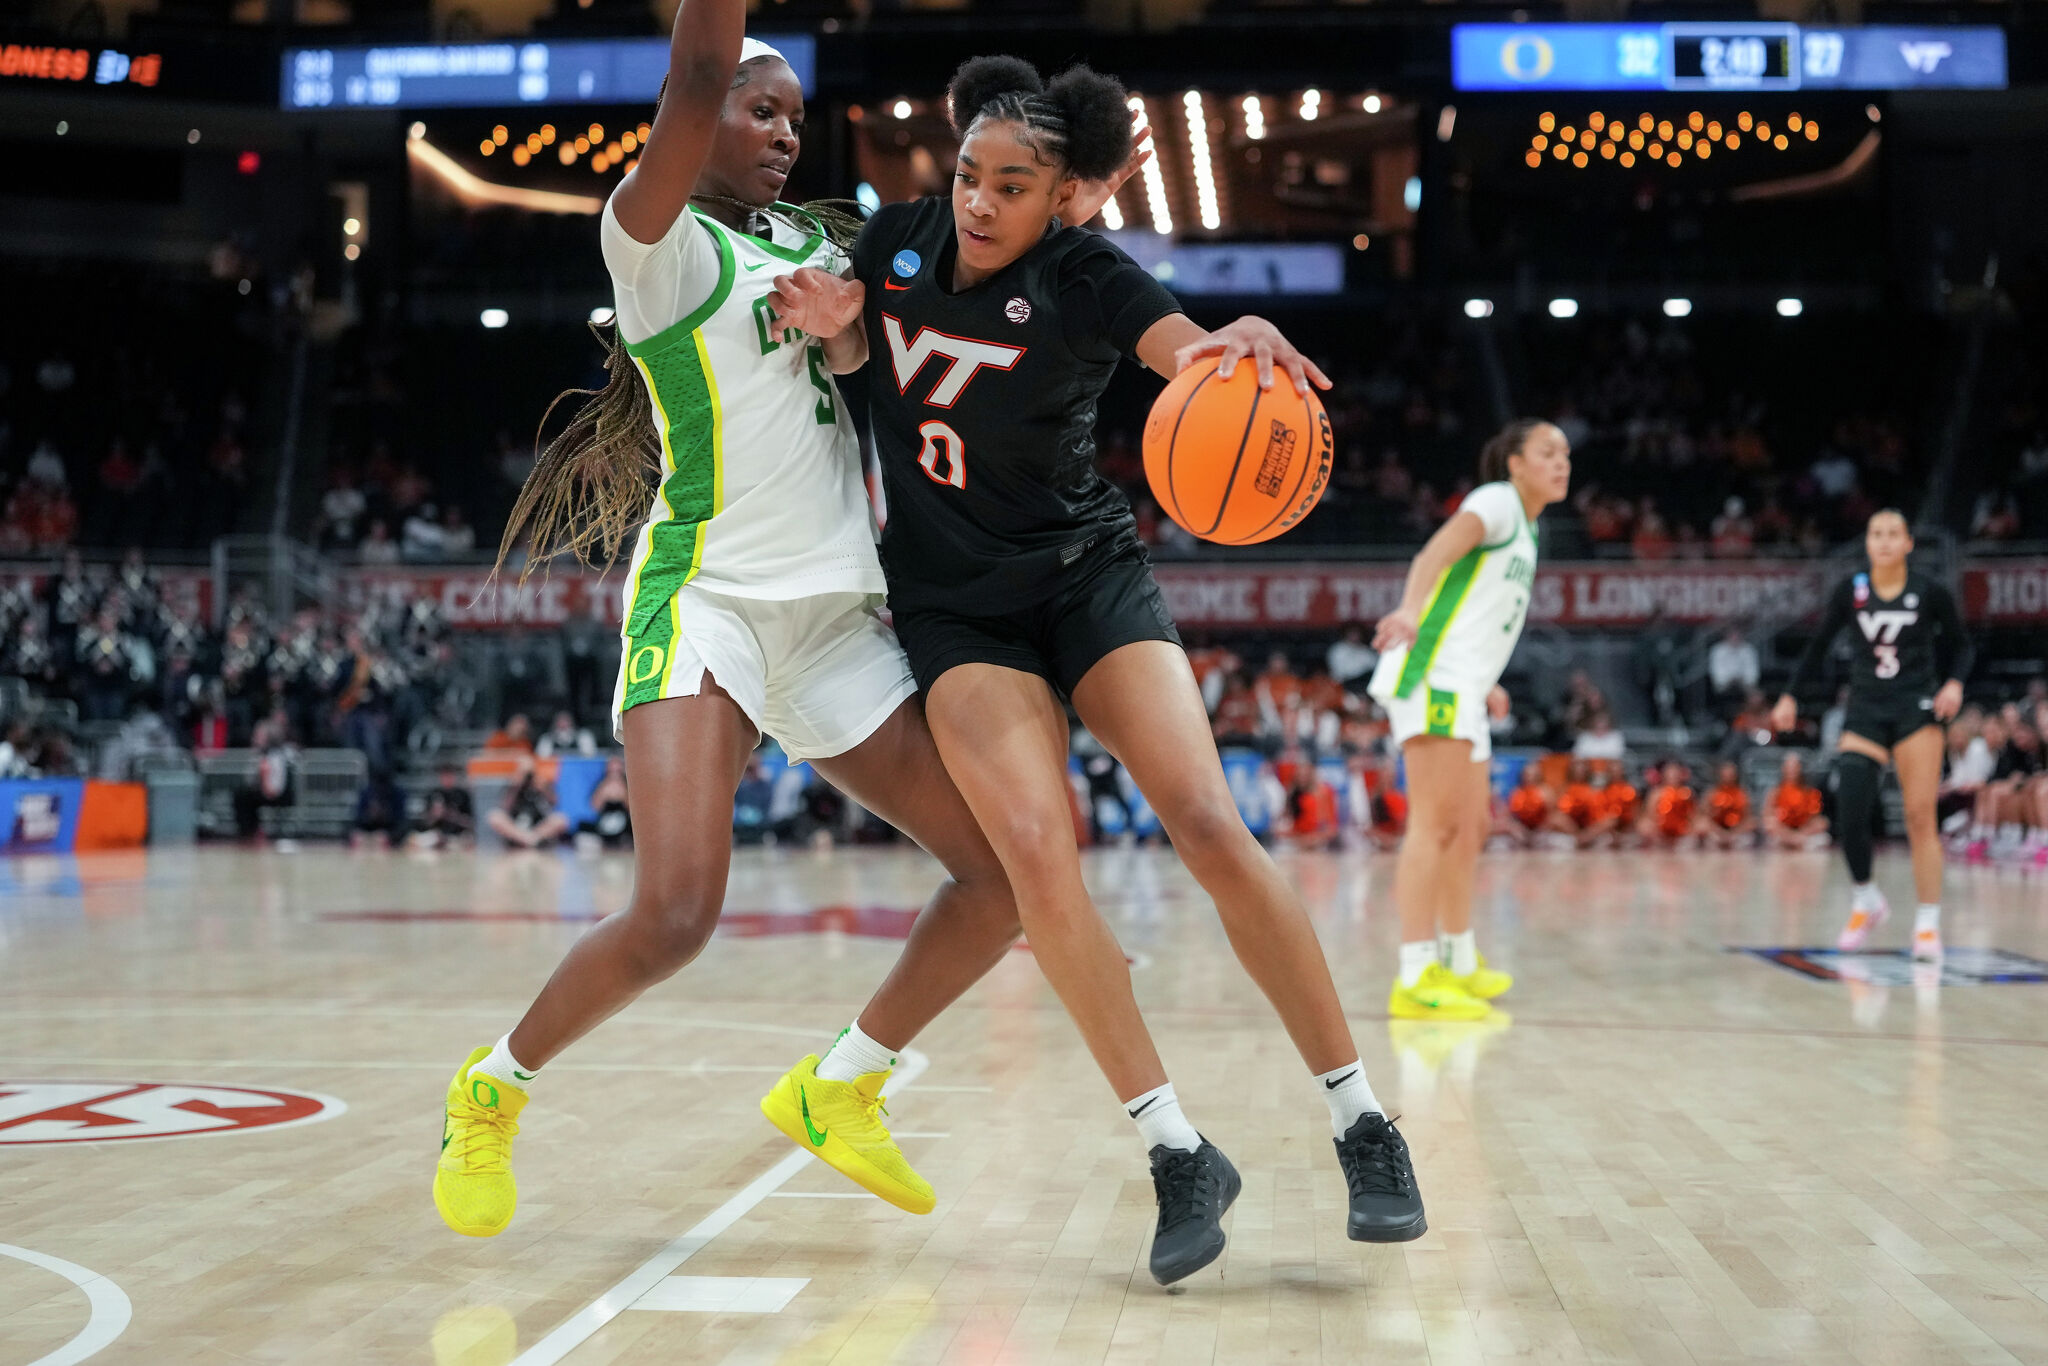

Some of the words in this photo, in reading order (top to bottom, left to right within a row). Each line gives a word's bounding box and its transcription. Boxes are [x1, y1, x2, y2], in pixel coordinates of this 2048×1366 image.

[0, 44, 90, 81] DNESS
[895, 257, 916, 276] NCAA
[881, 311, 1028, 409] VT
[917, 419, 966, 490] 0
[1256, 441, 1283, 494] MADNESS
[1273, 440, 1296, 481] MARCH
[1986, 572, 2048, 615] HO
[1856, 609, 1919, 644] VT
[629, 645, 665, 684] O
[1873, 644, 1901, 679] 3
